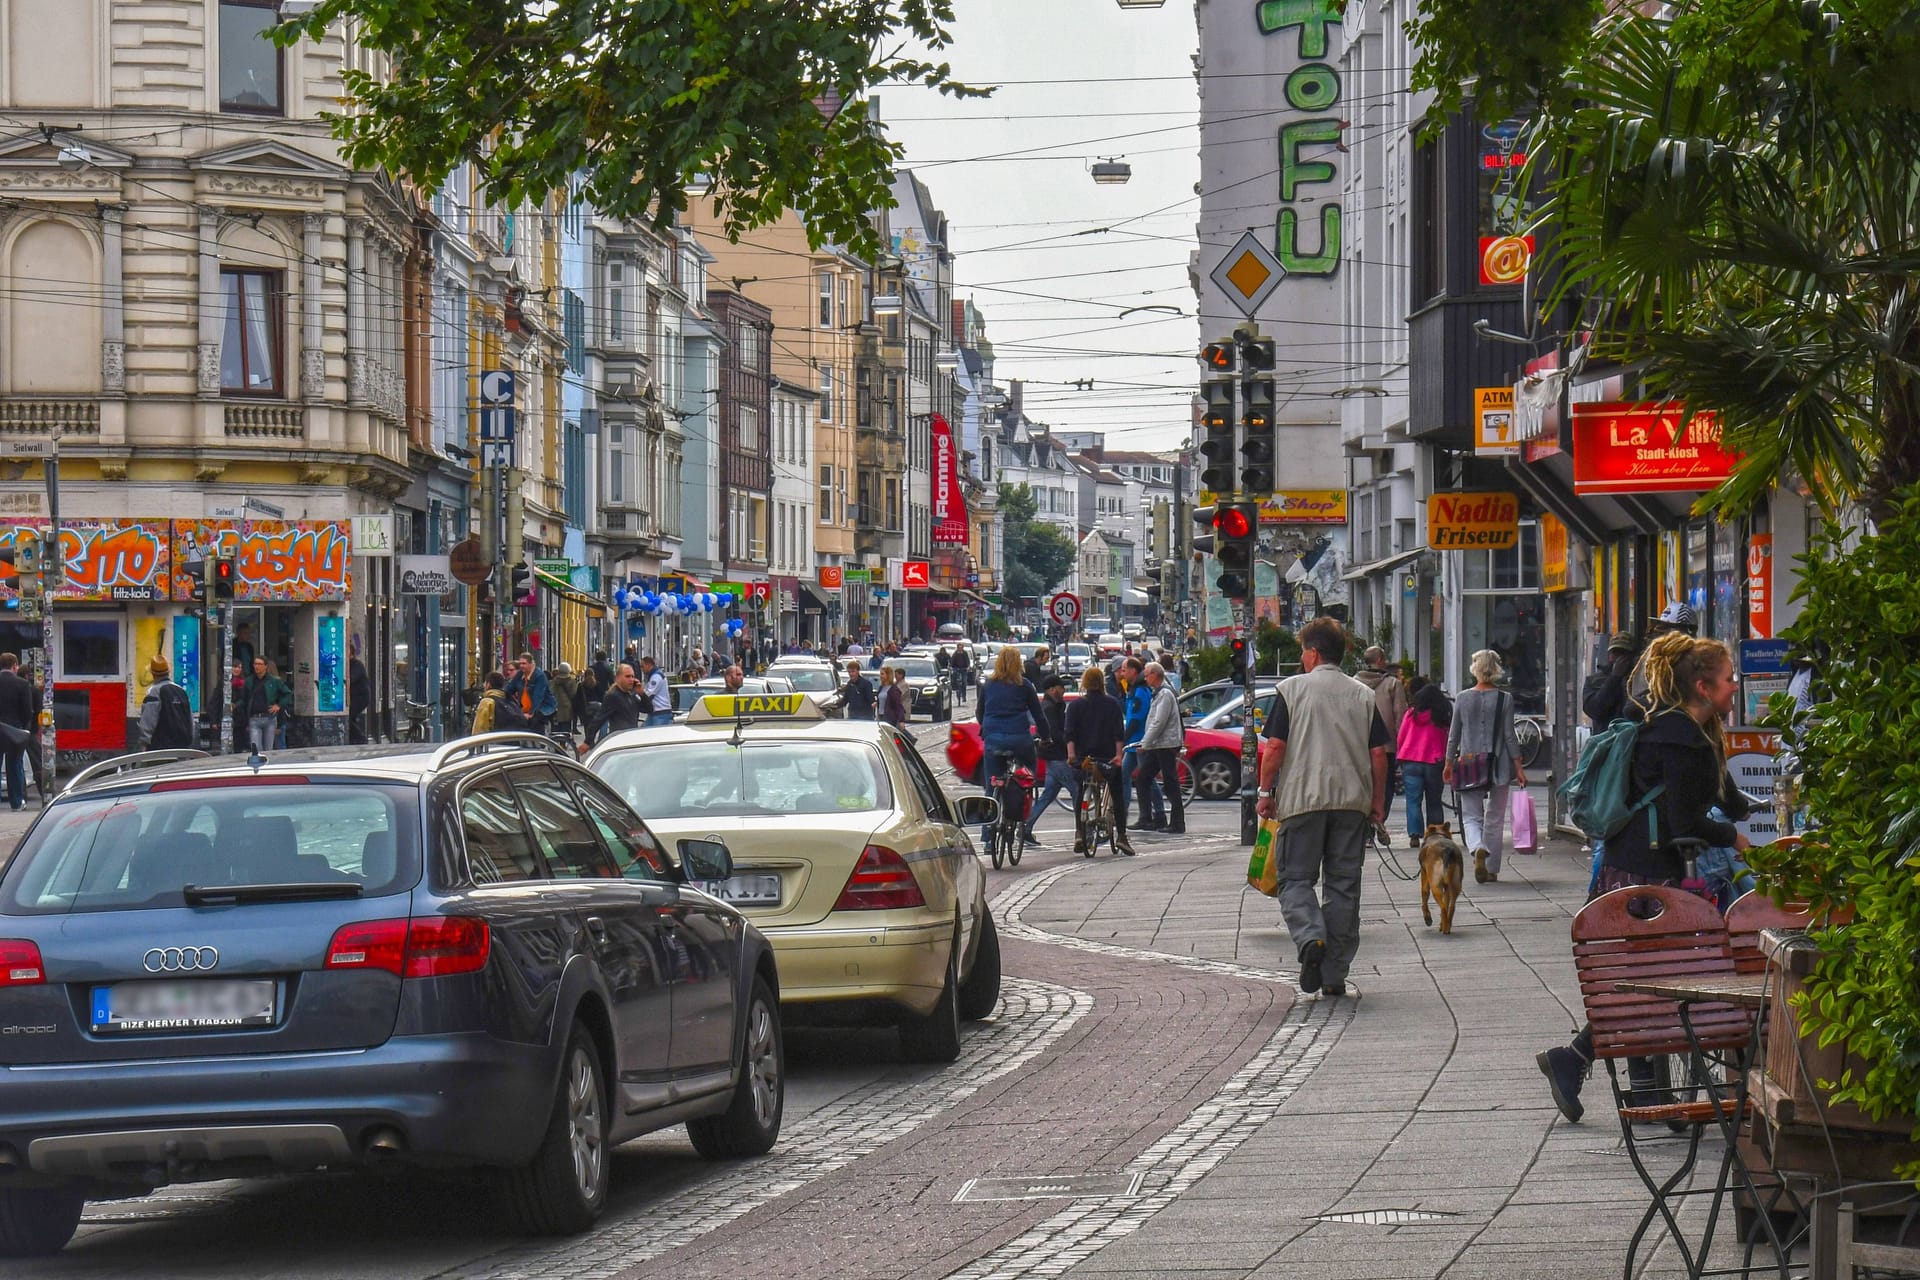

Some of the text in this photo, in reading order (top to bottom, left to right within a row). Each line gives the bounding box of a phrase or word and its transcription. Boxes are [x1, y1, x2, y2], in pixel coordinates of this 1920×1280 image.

[1257, 0, 1343, 277] TOFU
[1482, 391, 1513, 403] ATM
[1610, 419, 1648, 447] La
[13, 443, 43, 453] Sielwall
[1636, 446, 1699, 461] Stadt-Kiosk
[936, 434, 949, 518] Flamme
[1625, 460, 1711, 478] Klein aber fein
[1281, 496, 1333, 514] Shop
[1433, 497, 1514, 524] Nadia
[1435, 526, 1513, 545] Friseur
[113, 587, 151, 599] fritz-kola
[1055, 601, 1074, 617] 30
[736, 696, 790, 713] TAXI
[1731, 734, 1751, 749] La
[3, 1023, 57, 1034] allroad
